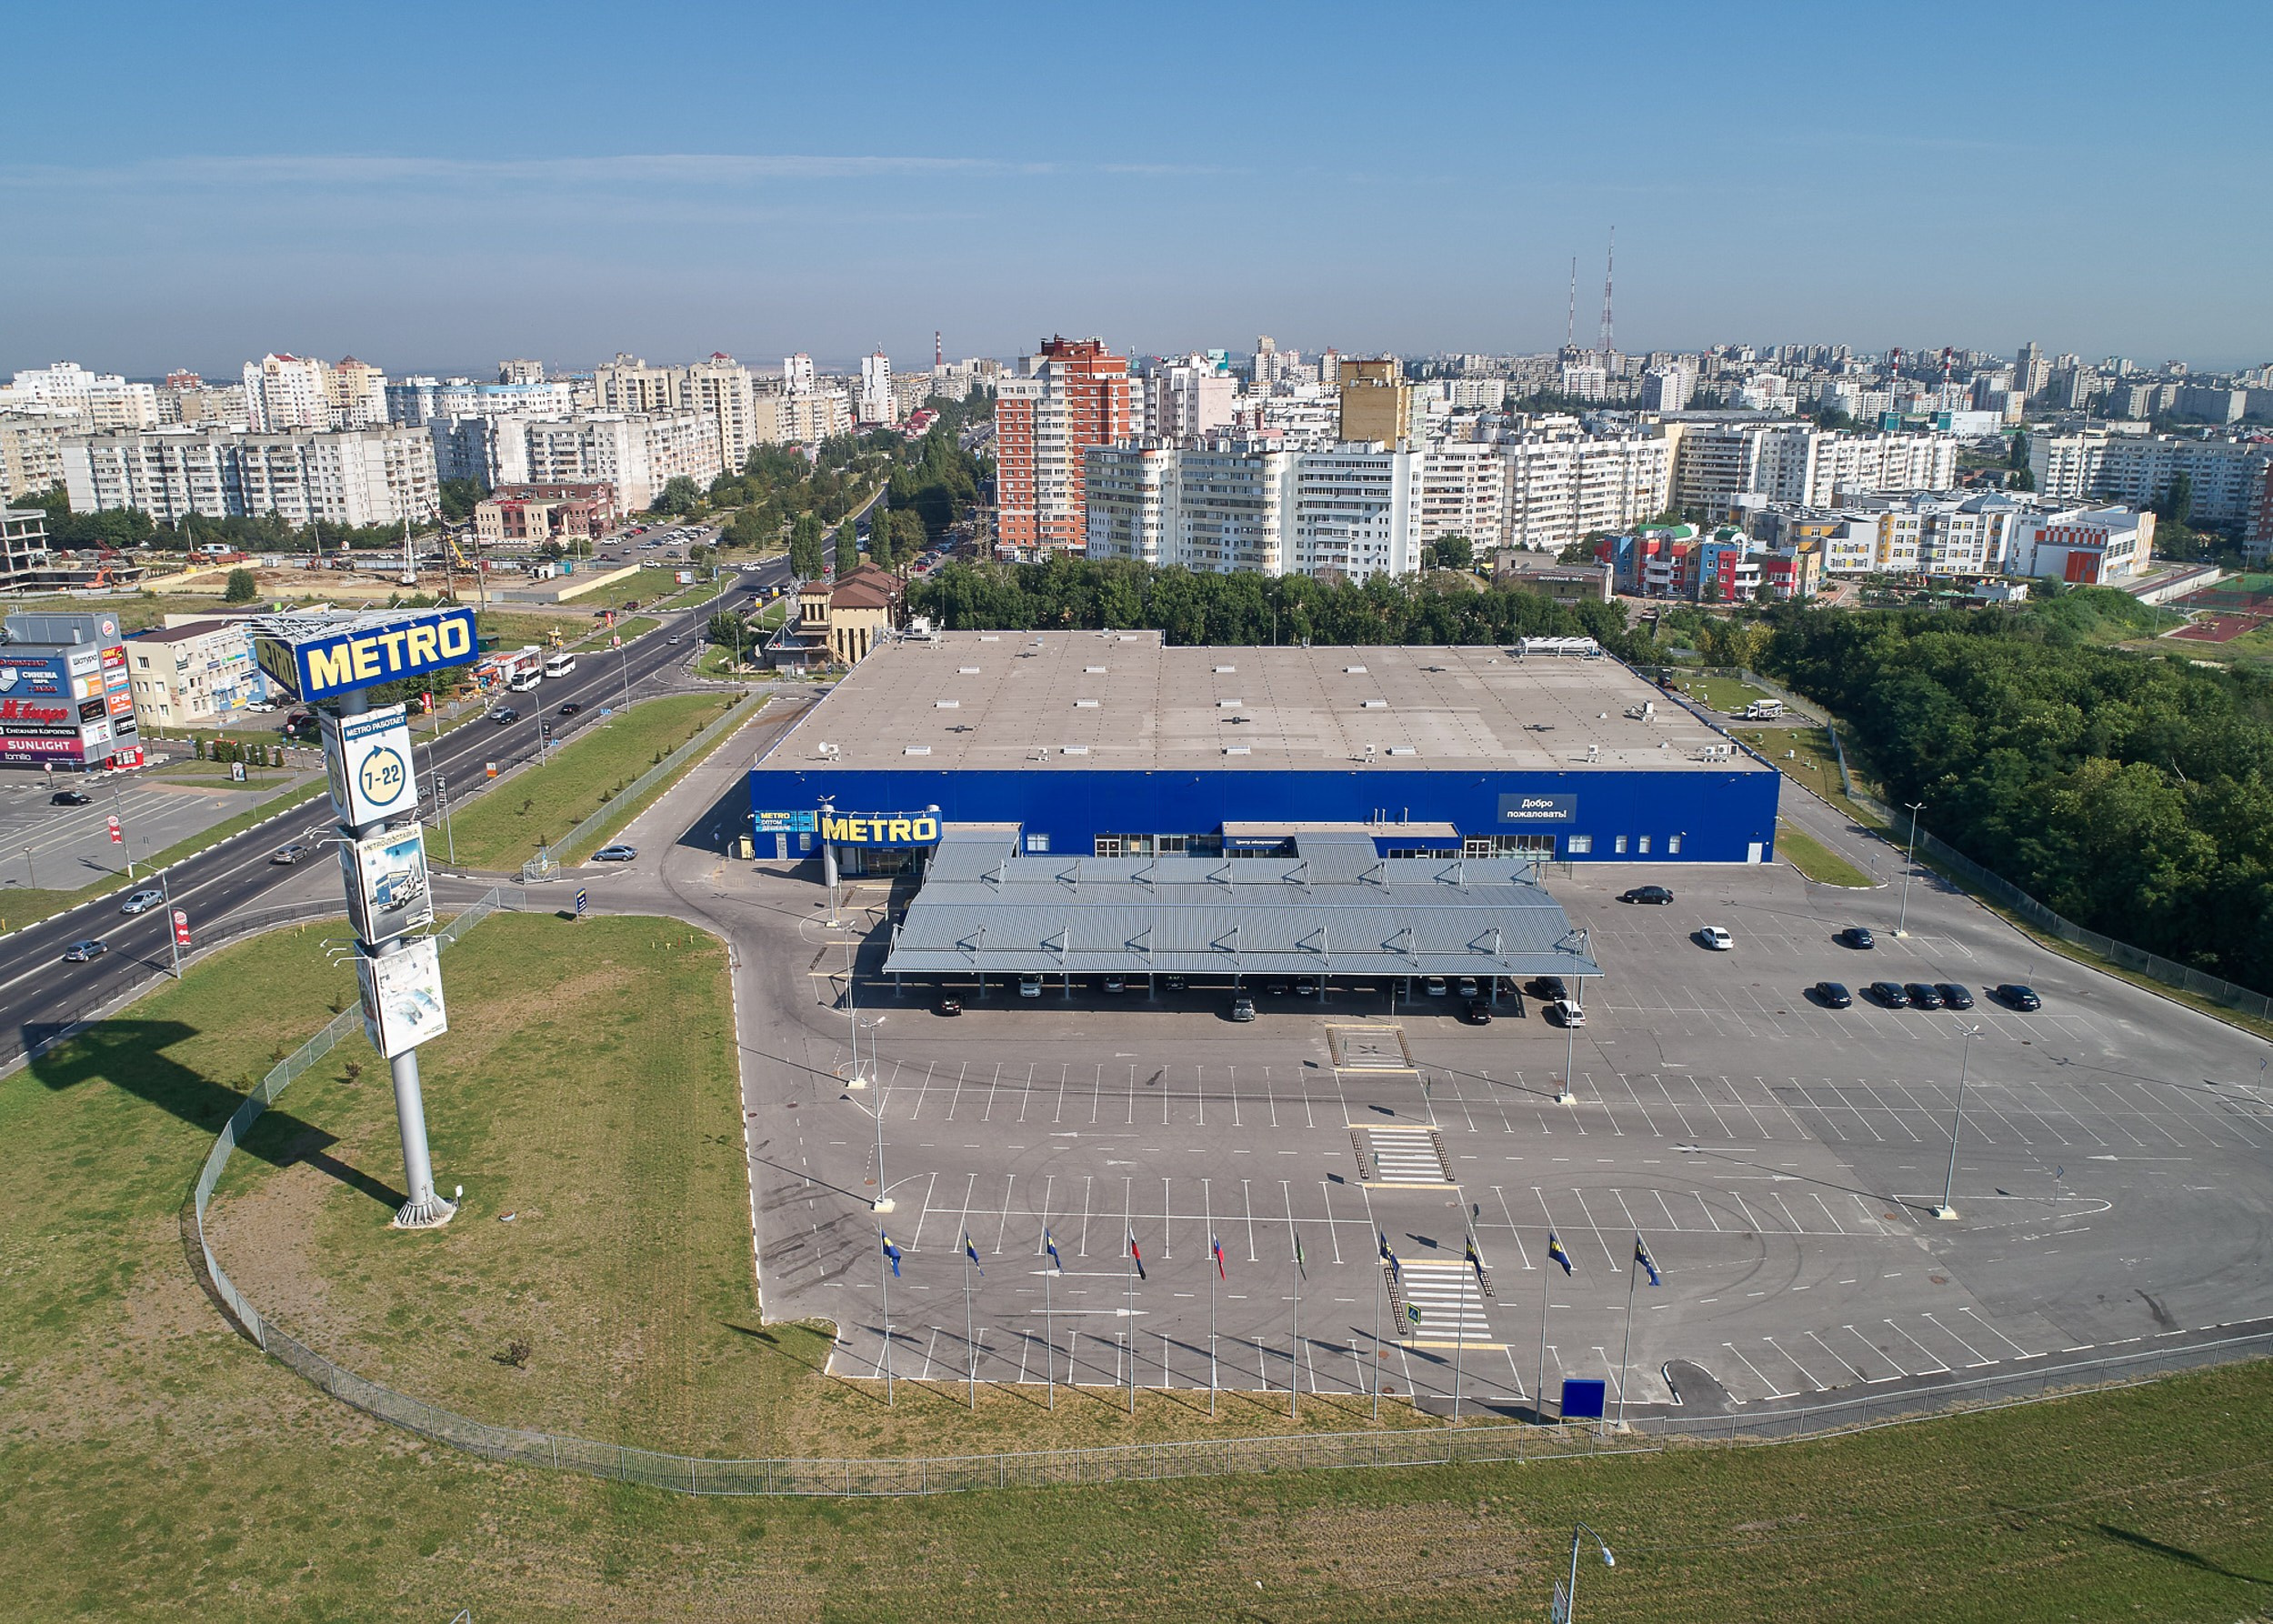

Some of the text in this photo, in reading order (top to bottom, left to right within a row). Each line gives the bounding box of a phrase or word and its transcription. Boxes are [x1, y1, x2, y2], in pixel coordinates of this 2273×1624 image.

[307, 617, 471, 691] METRO
[255, 639, 296, 690] METRO
[110, 692, 131, 705] DNS
[346, 716, 406, 737] METRO РАБОТАЕТ
[7, 740, 70, 750] SUNLIGHT
[1521, 798, 1554, 808] Добро
[1507, 809, 1567, 818] пожаловать!
[822, 817, 937, 842] METRO
